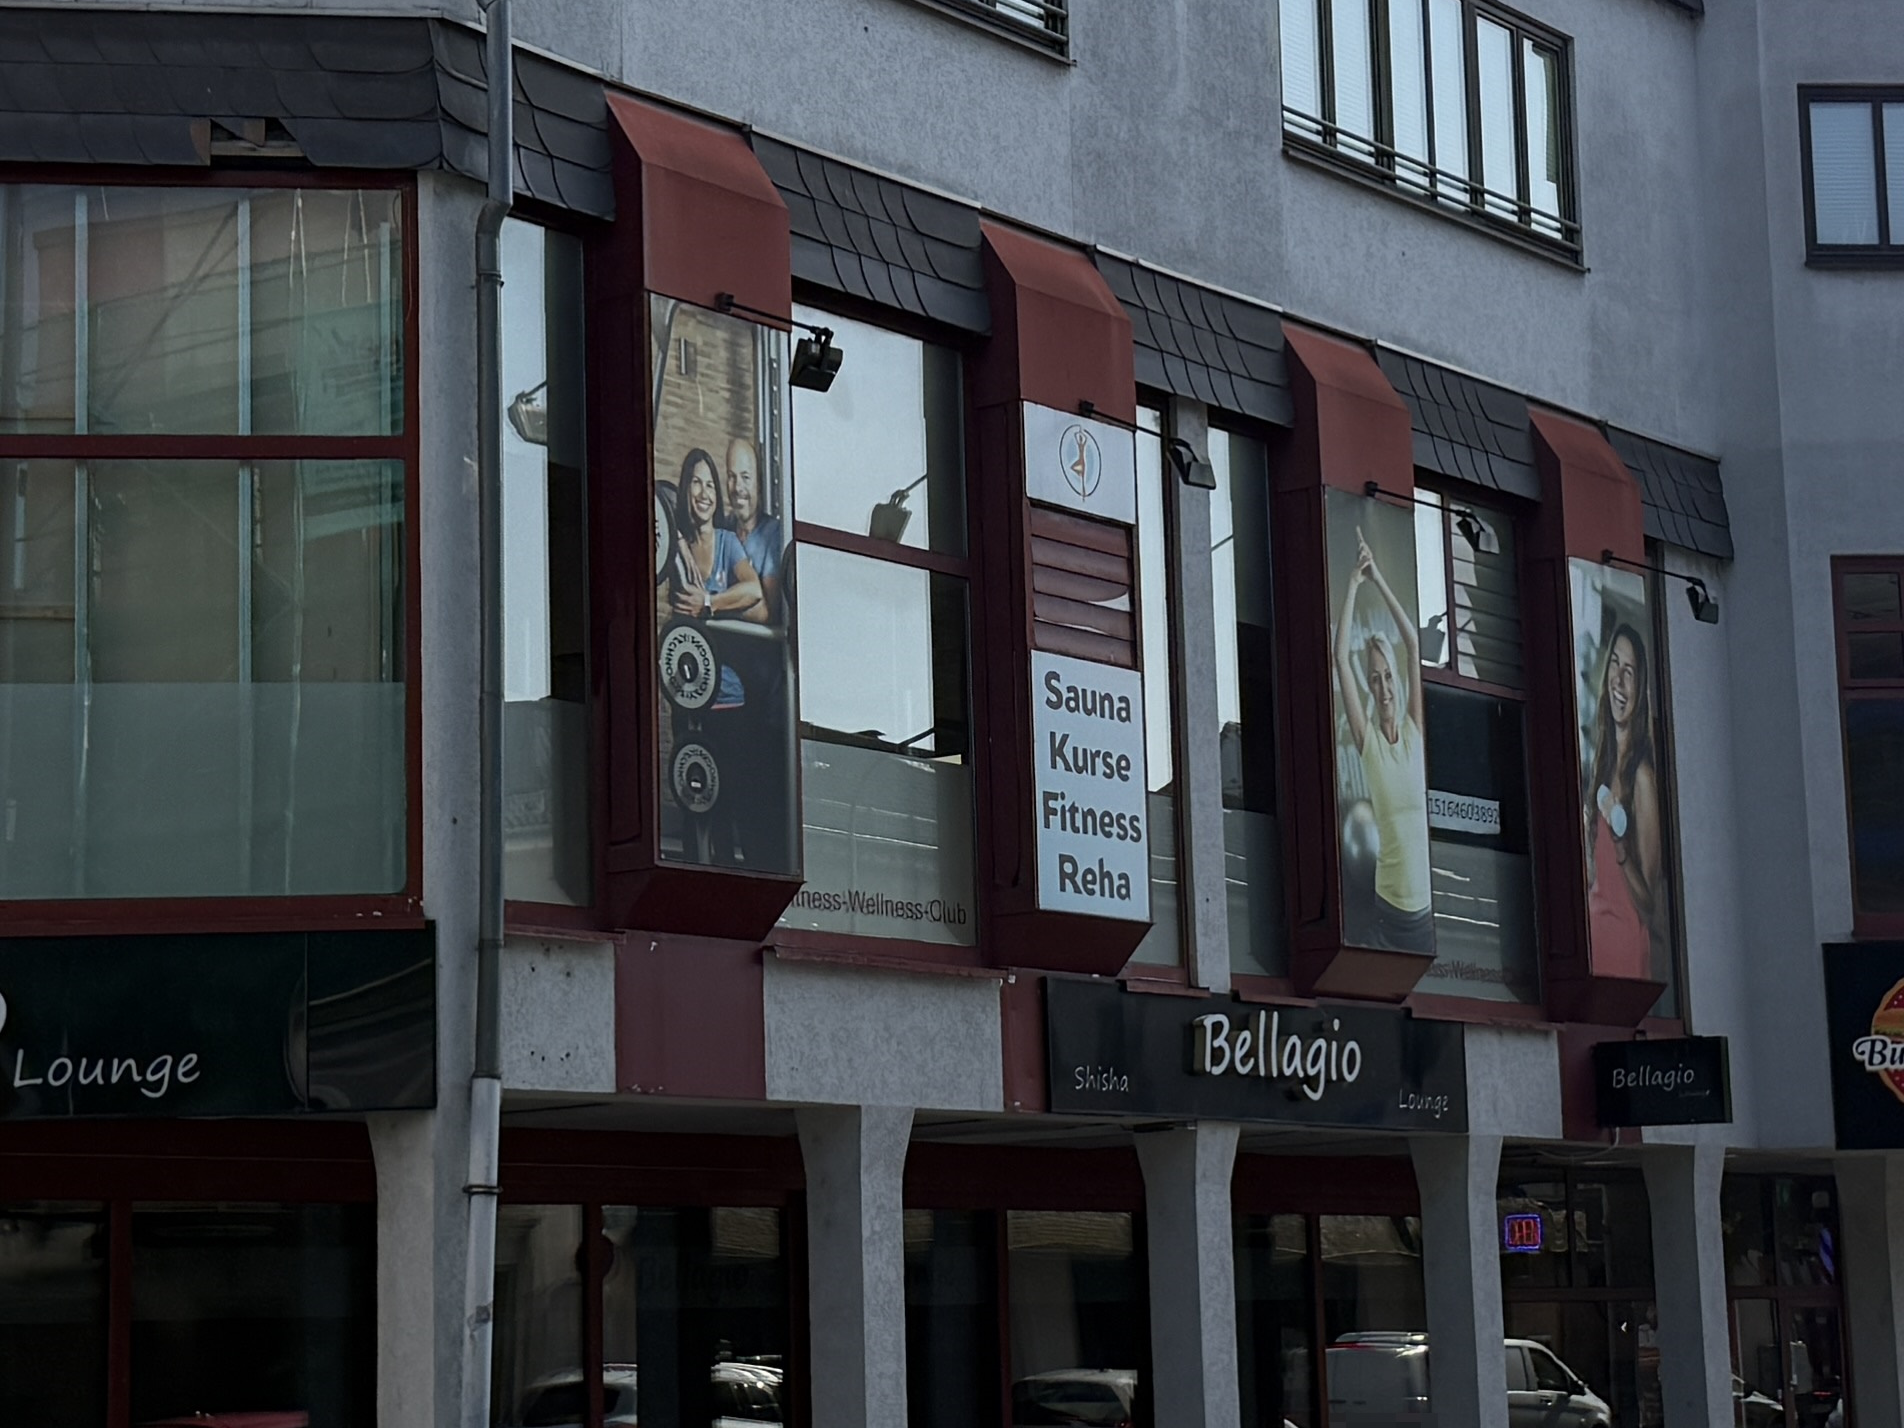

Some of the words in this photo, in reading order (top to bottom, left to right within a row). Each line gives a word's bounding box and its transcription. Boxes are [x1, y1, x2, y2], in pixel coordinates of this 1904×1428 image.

[1044, 670, 1132, 723] Sauna
[1049, 731, 1131, 782] Kurse
[1042, 790, 1142, 842] Fitness
[1058, 853, 1131, 901] Reha
[14, 1048, 200, 1098] Lounge
[1073, 1065, 1130, 1093] Shisha
[1202, 1010, 1362, 1100] Bellagio
[1612, 1063, 1695, 1091] Bellagio
[1398, 1089, 1449, 1119] Lounge
